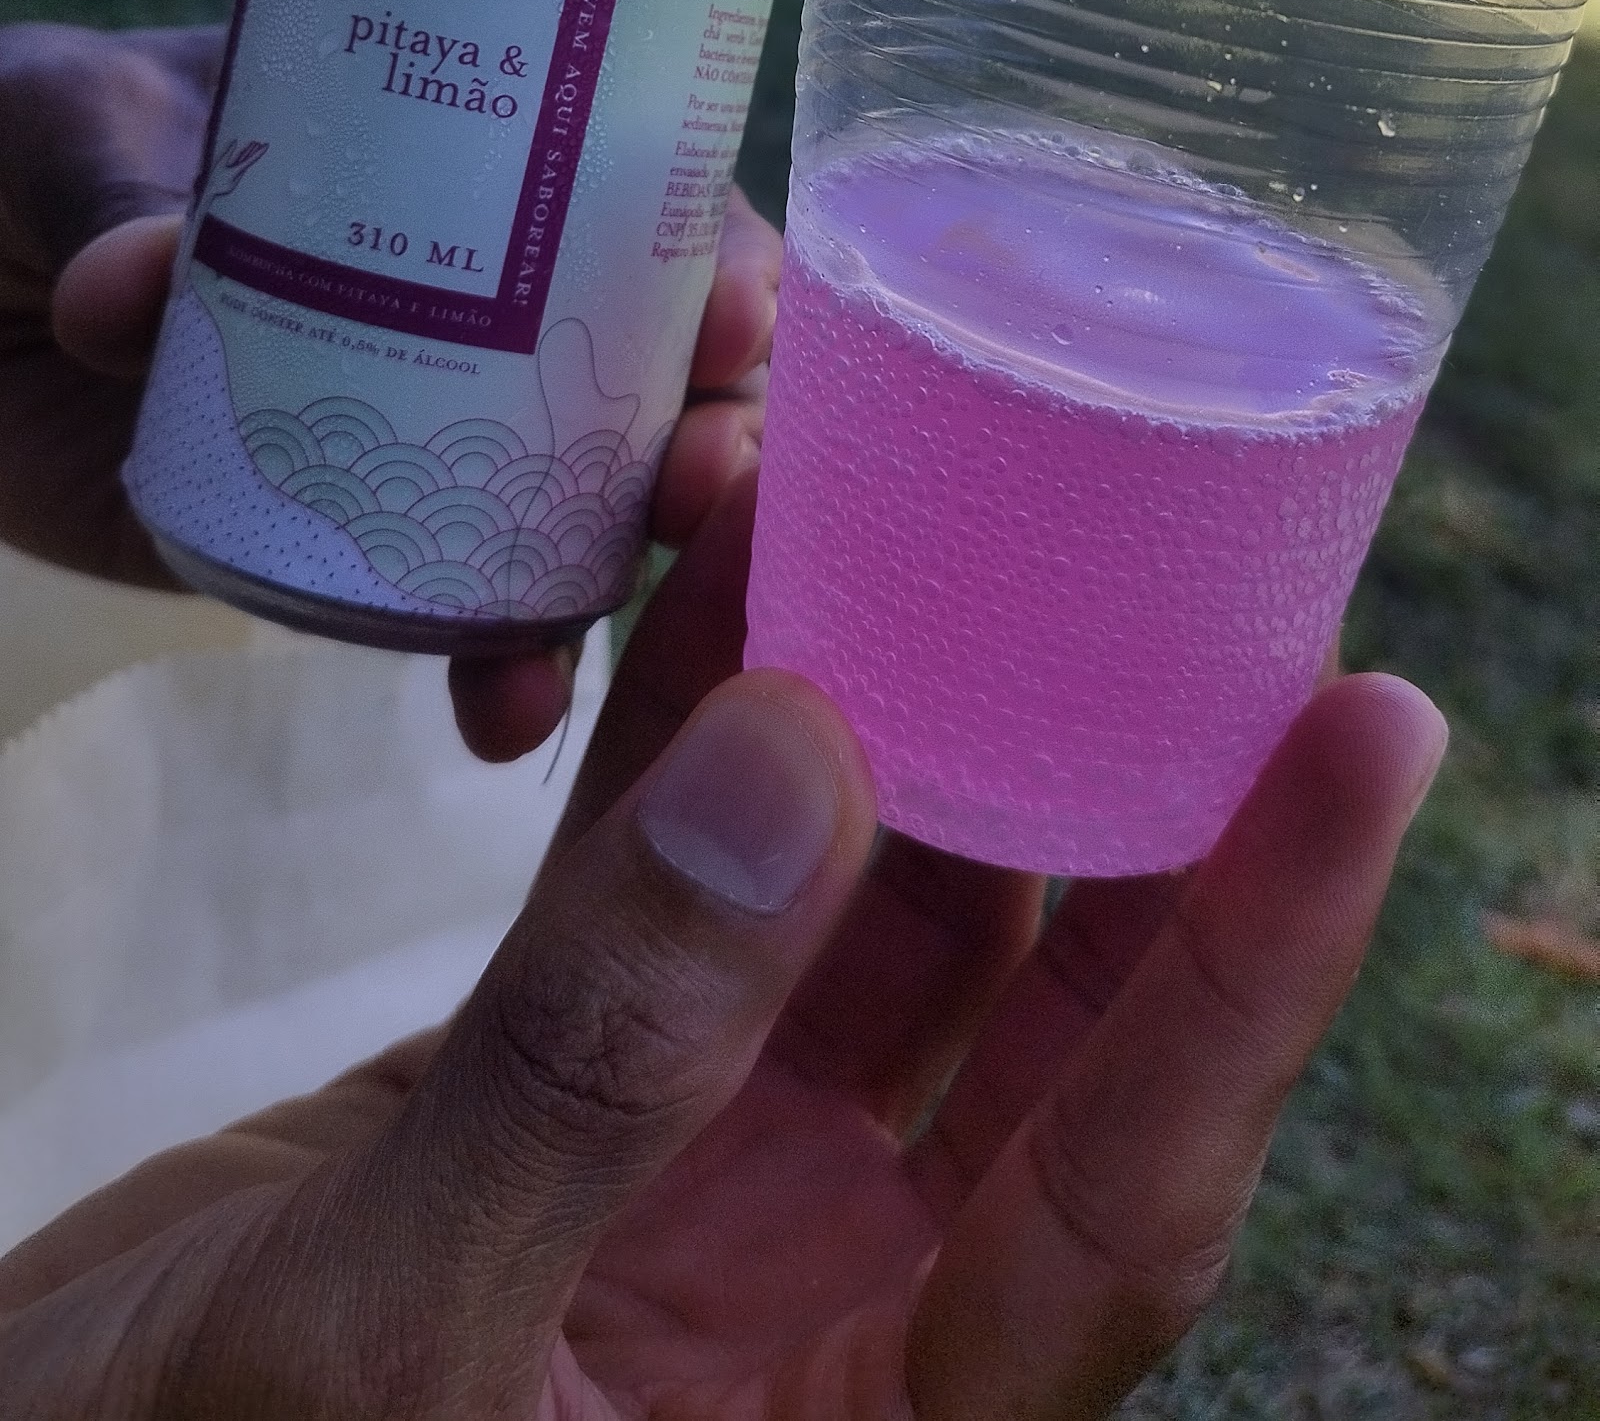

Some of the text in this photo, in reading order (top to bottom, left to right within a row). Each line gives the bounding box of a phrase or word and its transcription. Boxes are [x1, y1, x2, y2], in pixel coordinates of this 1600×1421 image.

[344, 11, 529, 77] pitaya &
[382, 51, 518, 118] limão
[553, 63, 582, 136] AQUI
[348, 221, 485, 272] 310 ML
[513, 149, 562, 305] SABOREAR!
[430, 306, 492, 327] LIMÃO
[386, 346, 409, 361] DE
[412, 349, 481, 375] ÁLCOOL
